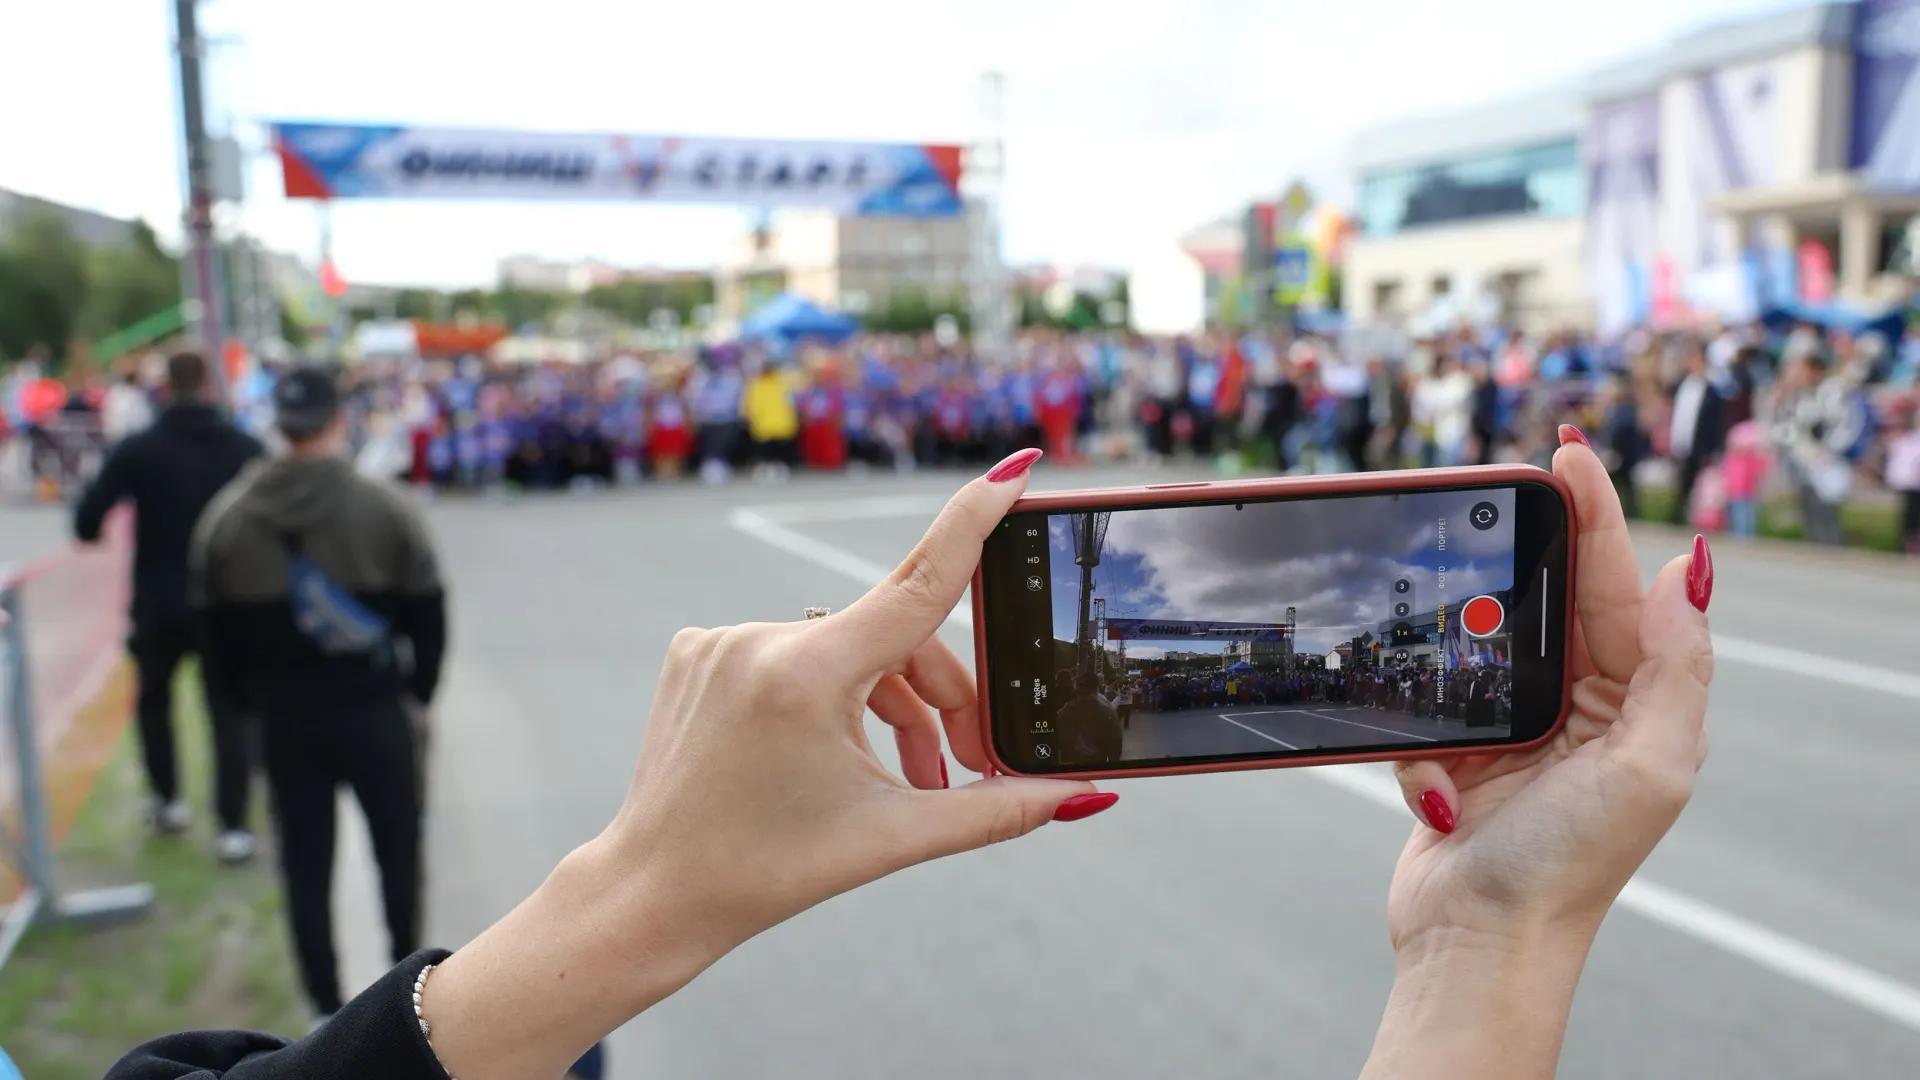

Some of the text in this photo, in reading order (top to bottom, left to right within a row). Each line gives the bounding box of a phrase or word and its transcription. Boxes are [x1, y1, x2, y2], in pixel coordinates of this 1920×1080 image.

[1026, 529, 1038, 537] 60
[1438, 518, 1446, 551] ПОРТРЕТ
[1027, 556, 1040, 564] HD
[1438, 565, 1446, 589] ФОТО
[1437, 603, 1446, 633] ВИДЕО
[1139, 625, 1261, 637] ФИНИШ СТАРТ
[1396, 652, 1407, 660] 0,5
[1437, 648, 1445, 703] КИНОЭФФЕКТ
[1035, 721, 1048, 729] 0,0
